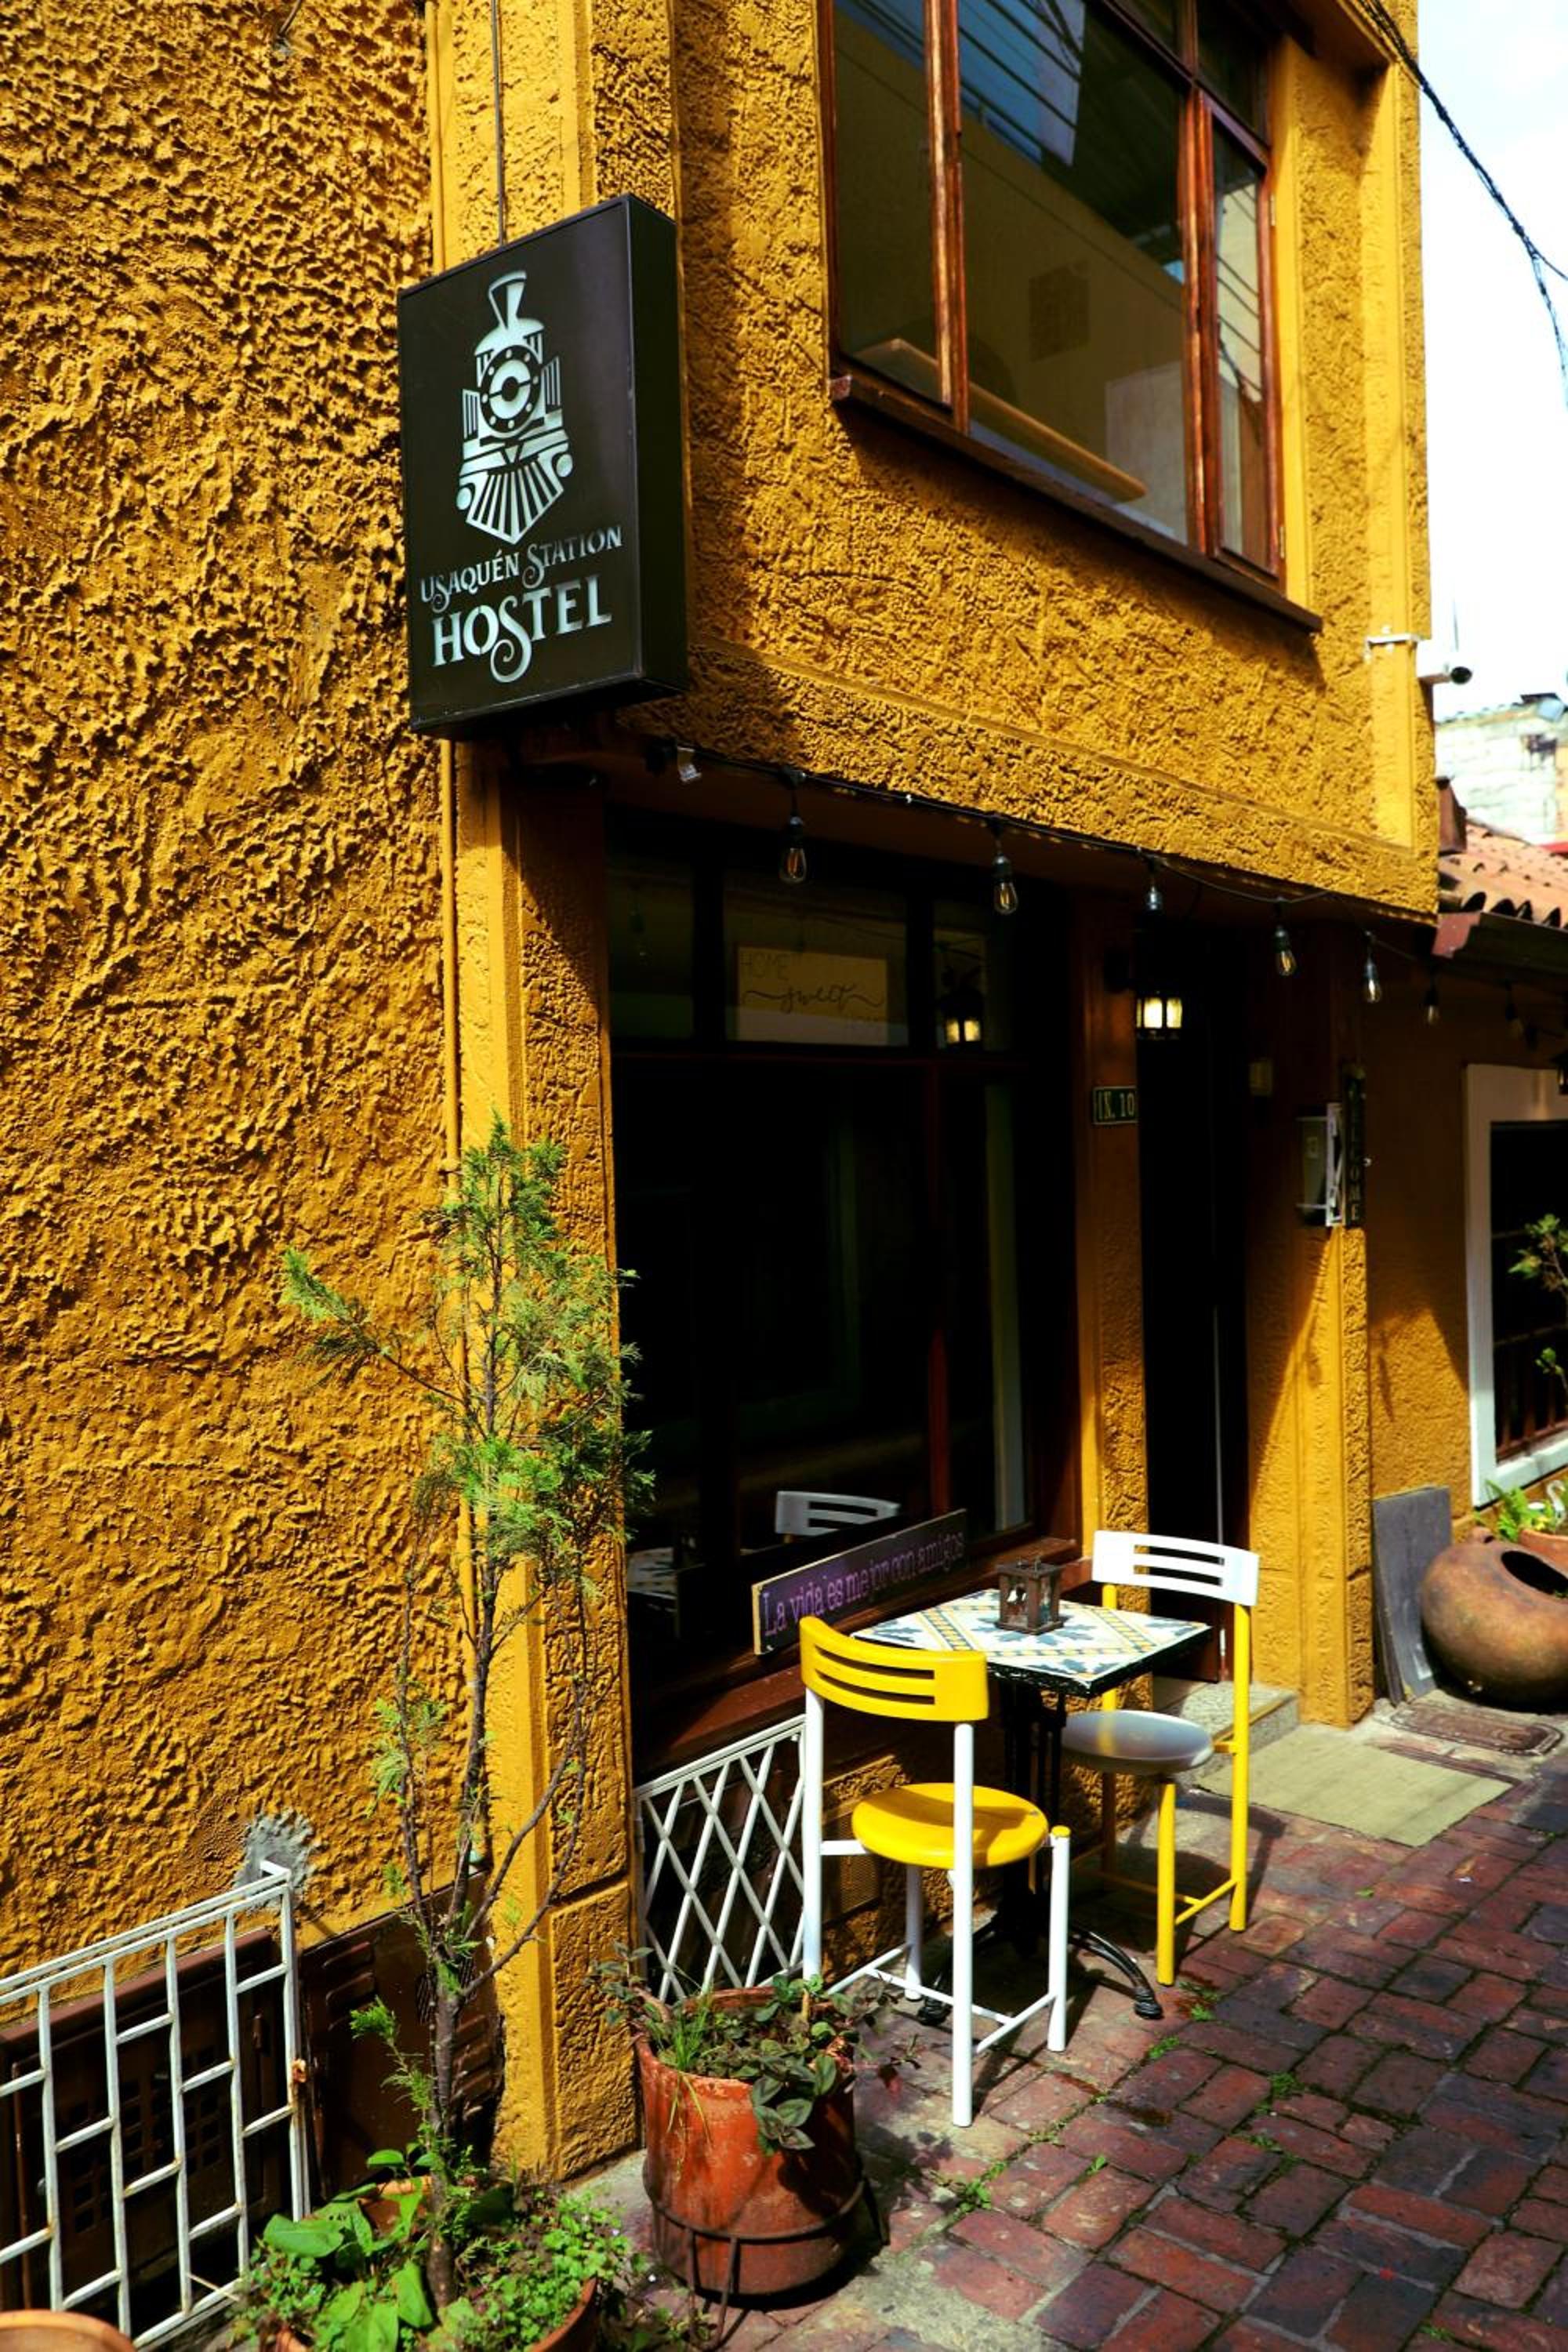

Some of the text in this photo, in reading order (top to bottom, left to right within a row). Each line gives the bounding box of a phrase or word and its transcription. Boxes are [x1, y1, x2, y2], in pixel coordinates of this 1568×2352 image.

[421, 549, 520, 613] USAQUÉN
[432, 575, 612, 684] HOSTEL
[1119, 1092, 1134, 1117] 10
[762, 1531, 966, 1636] La vida es mejor con amigos
